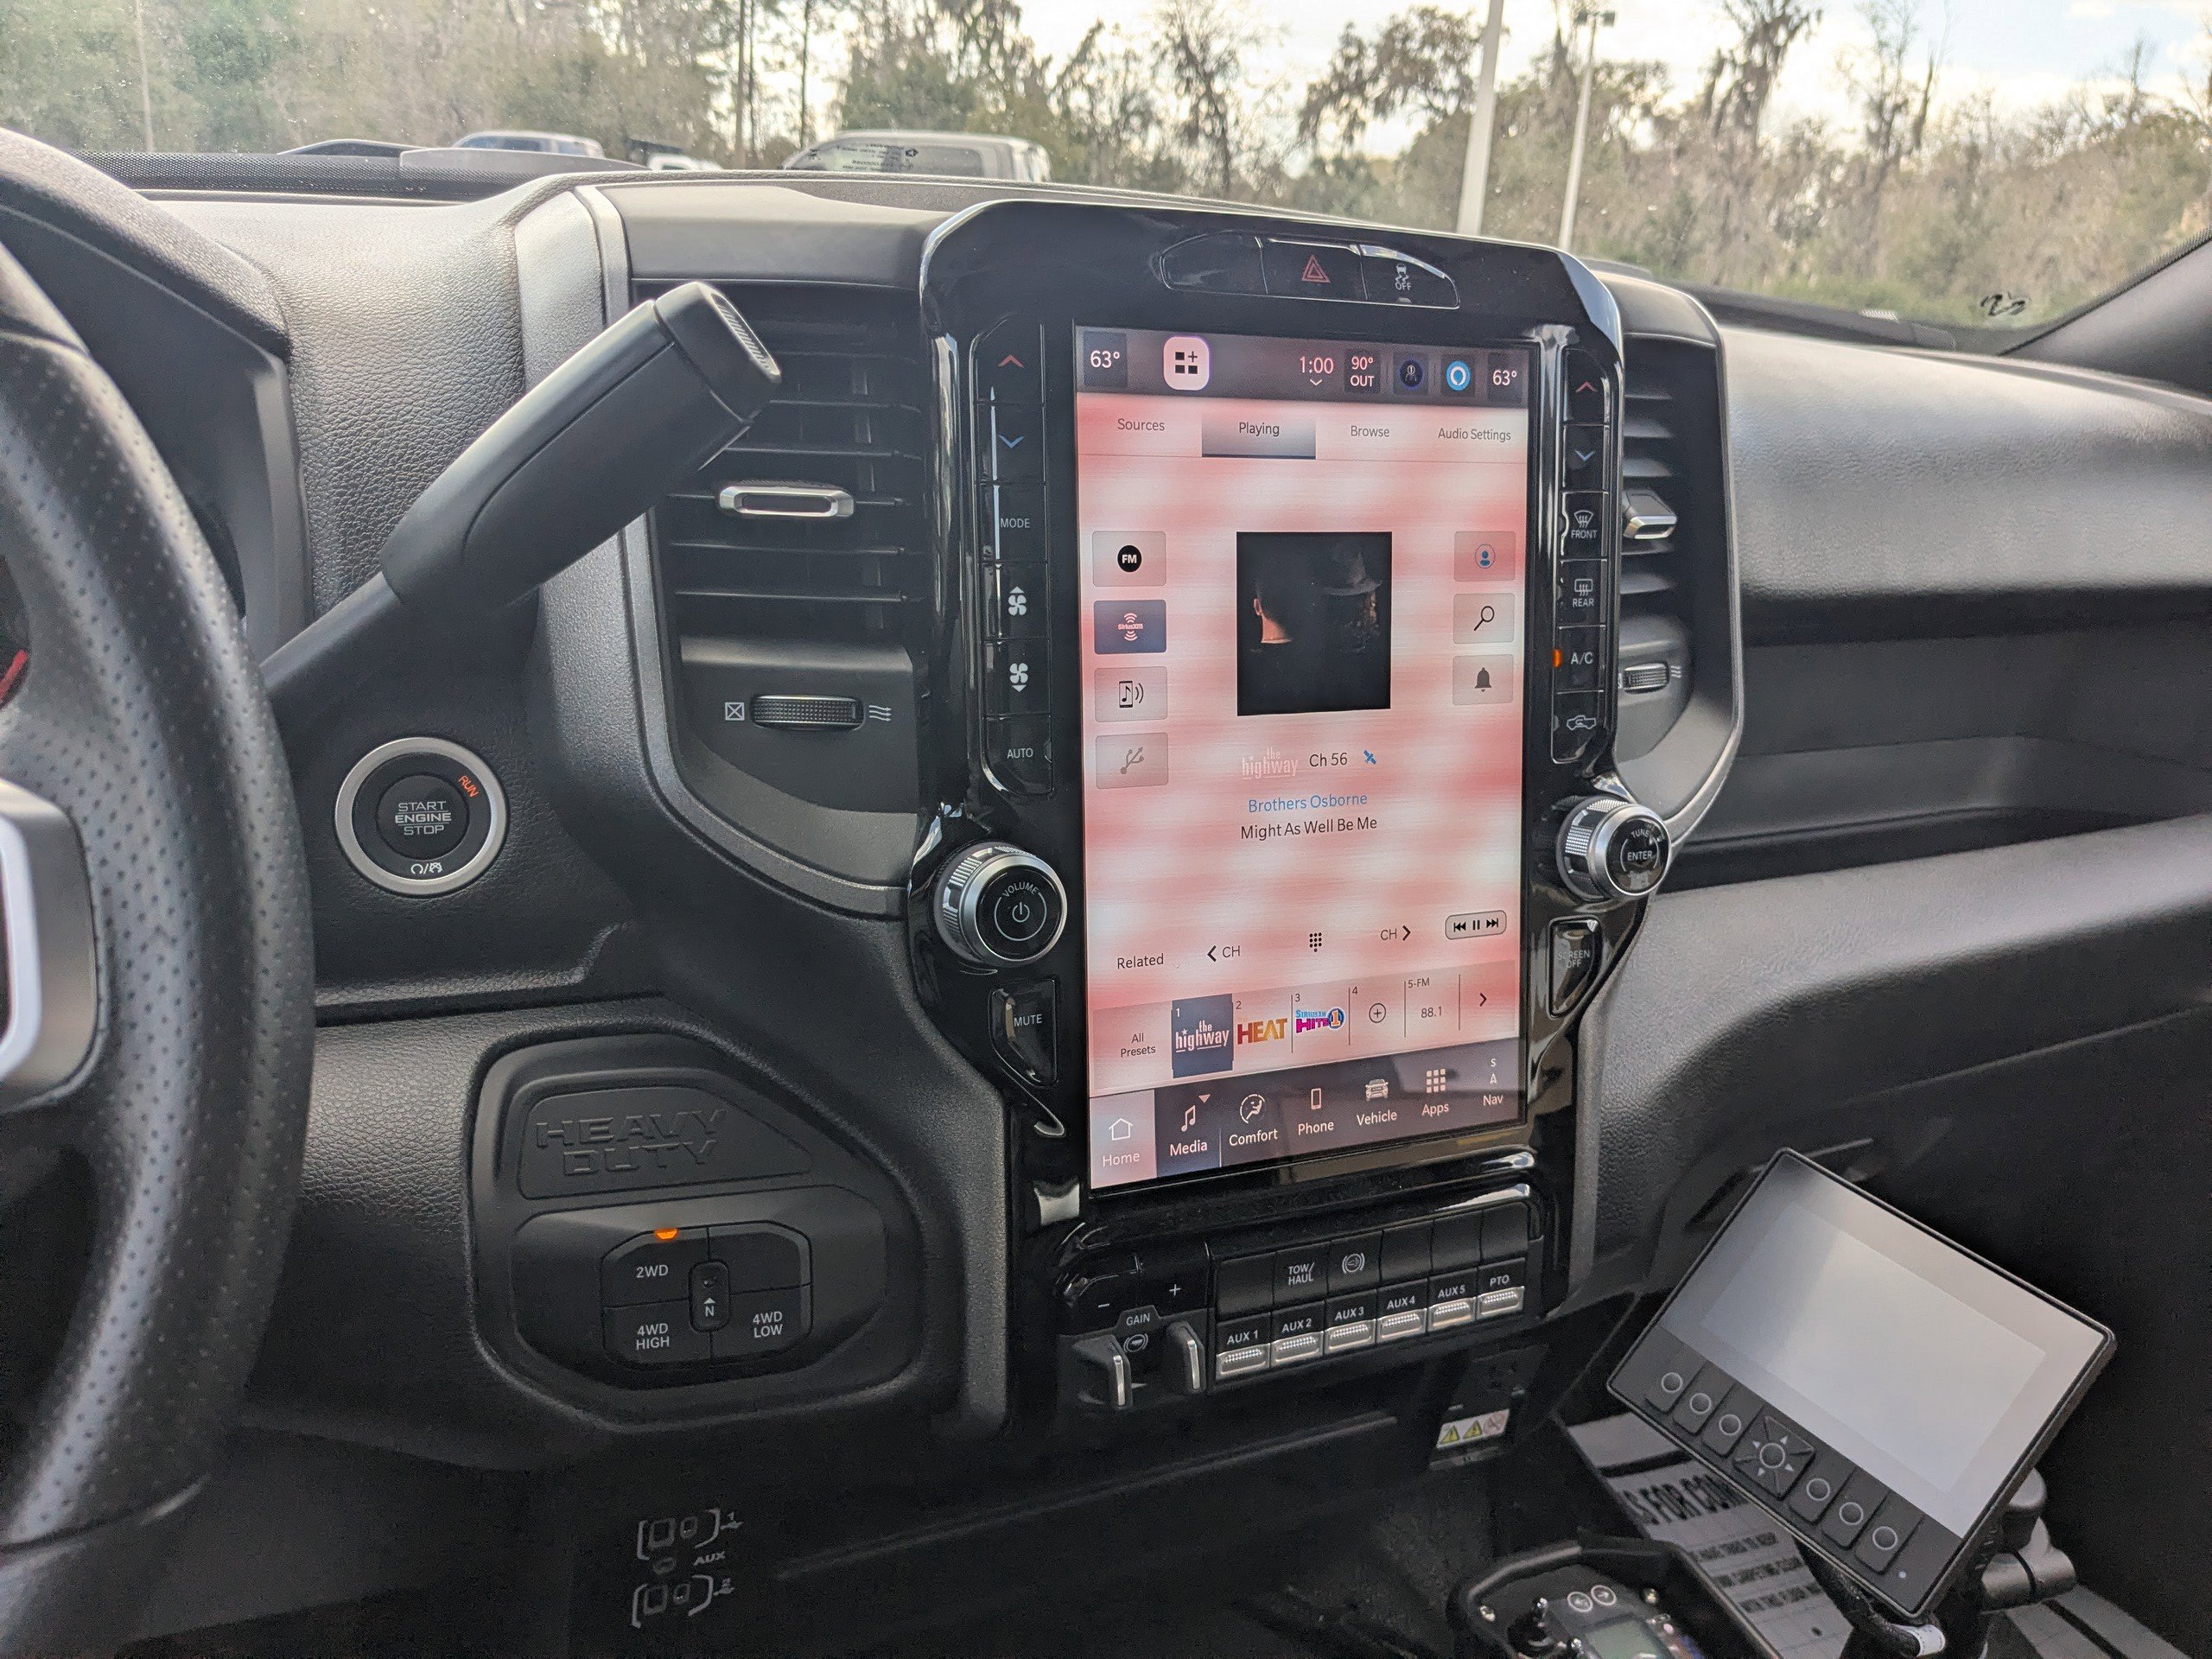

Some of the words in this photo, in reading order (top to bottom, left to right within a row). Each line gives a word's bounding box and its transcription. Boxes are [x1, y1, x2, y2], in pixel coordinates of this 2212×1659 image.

[1395, 281, 1412, 291] OFF
[1090, 350, 1121, 369] 63°
[1300, 355, 1334, 375] 1:00
[1351, 355, 1374, 371] 90°
[1350, 375, 1375, 387] OUT
[1492, 369, 1517, 386] 63°
[1117, 418, 1165, 431] Sources
[1238, 422, 1280, 437] Playing
[1351, 425, 1390, 438] Browse
[1438, 428, 1468, 440] Audio
[1470, 429, 1511, 443] Settings
[1000, 518, 1031, 529] MODE
[1571, 530, 1598, 540] FRONT
[1122, 554, 1137, 564] FM
[1572, 598, 1595, 607] REAR
[1570, 652, 1593, 664] A/C
[1007, 747, 1034, 760] AUTO
[1266, 747, 1281, 760] the
[1309, 753, 1327, 767] Ch
[1331, 753, 1348, 766] 56
[1242, 755, 1299, 779] highway
[459, 776, 480, 798] RUN
[398, 801, 447, 811] START
[1249, 798, 1306, 813] Brothers
[1310, 793, 1368, 809] Osborne
[395, 812, 452, 823] ENGINE
[404, 825, 444, 836] STOP
[1241, 823, 1281, 842] Might
[1284, 823, 1301, 836] As
[1304, 819, 1333, 835] Well
[1337, 818, 1354, 831] Be
[1357, 817, 1377, 830] Me
[1630, 828, 1650, 839] TUNE
[1627, 850, 1653, 861] ENTER
[1002, 881, 1039, 899] VOLUME
[1380, 928, 1397, 941] CH
[1222, 945, 1241, 958] CH
[1558, 950, 1591, 961] SCREEN
[1117, 953, 1164, 969] Related
[1567, 960, 1582, 969] OFF
[1408, 977, 1430, 988] 5-FM
[1352, 986, 1358, 995] 4
[1236, 1001, 1242, 1009] 2
[1421, 1006, 1442, 1018] 88.1
[1014, 1014, 1043, 1027] MUTE
[1199, 1020, 1212, 1032] the
[1295, 1018, 1329, 1033] HITS
[1132, 1033, 1144, 1043] All
[1237, 1018, 1287, 1045] HEAT
[1175, 1029, 1230, 1052] highway
[1121, 1045, 1156, 1057] Presets
[1483, 1094, 1503, 1106] Nav
[1421, 1103, 1449, 1117] Apps
[1357, 1110, 1397, 1126] Vehicle
[536, 1109, 724, 1149] HEAVY
[1298, 1121, 1334, 1135] Phone
[1229, 1128, 1278, 1147] Comfort
[1170, 1140, 1208, 1156] Media
[563, 1139, 717, 1177] DUTY
[1103, 1151, 1140, 1166] Home
[636, 1264, 669, 1278] 2WD
[1288, 1262, 1315, 1274] TOW/
[1288, 1274, 1313, 1286] HAUL
[1490, 1274, 1510, 1287] PTO
[1438, 1287, 1458, 1299] AUX
[1460, 1285, 1466, 1294] 5
[1387, 1298, 1410, 1310] AUX
[1410, 1295, 1416, 1306] 4
[705, 1306, 715, 1317] N
[752, 1311, 783, 1325] 4WD
[1335, 1308, 1357, 1321] AUX
[1359, 1306, 1364, 1316] 3
[1126, 1313, 1151, 1326] GAIN
[1281, 1319, 1304, 1333] AUX
[1306, 1318, 1312, 1328] 2
[637, 1323, 669, 1337] 4WD
[753, 1324, 783, 1338] LOW
[635, 1336, 670, 1351] HIGH
[1226, 1332, 1249, 1345] AUX
[1253, 1330, 1258, 1339] 1
[693, 1550, 726, 1567] AUX
